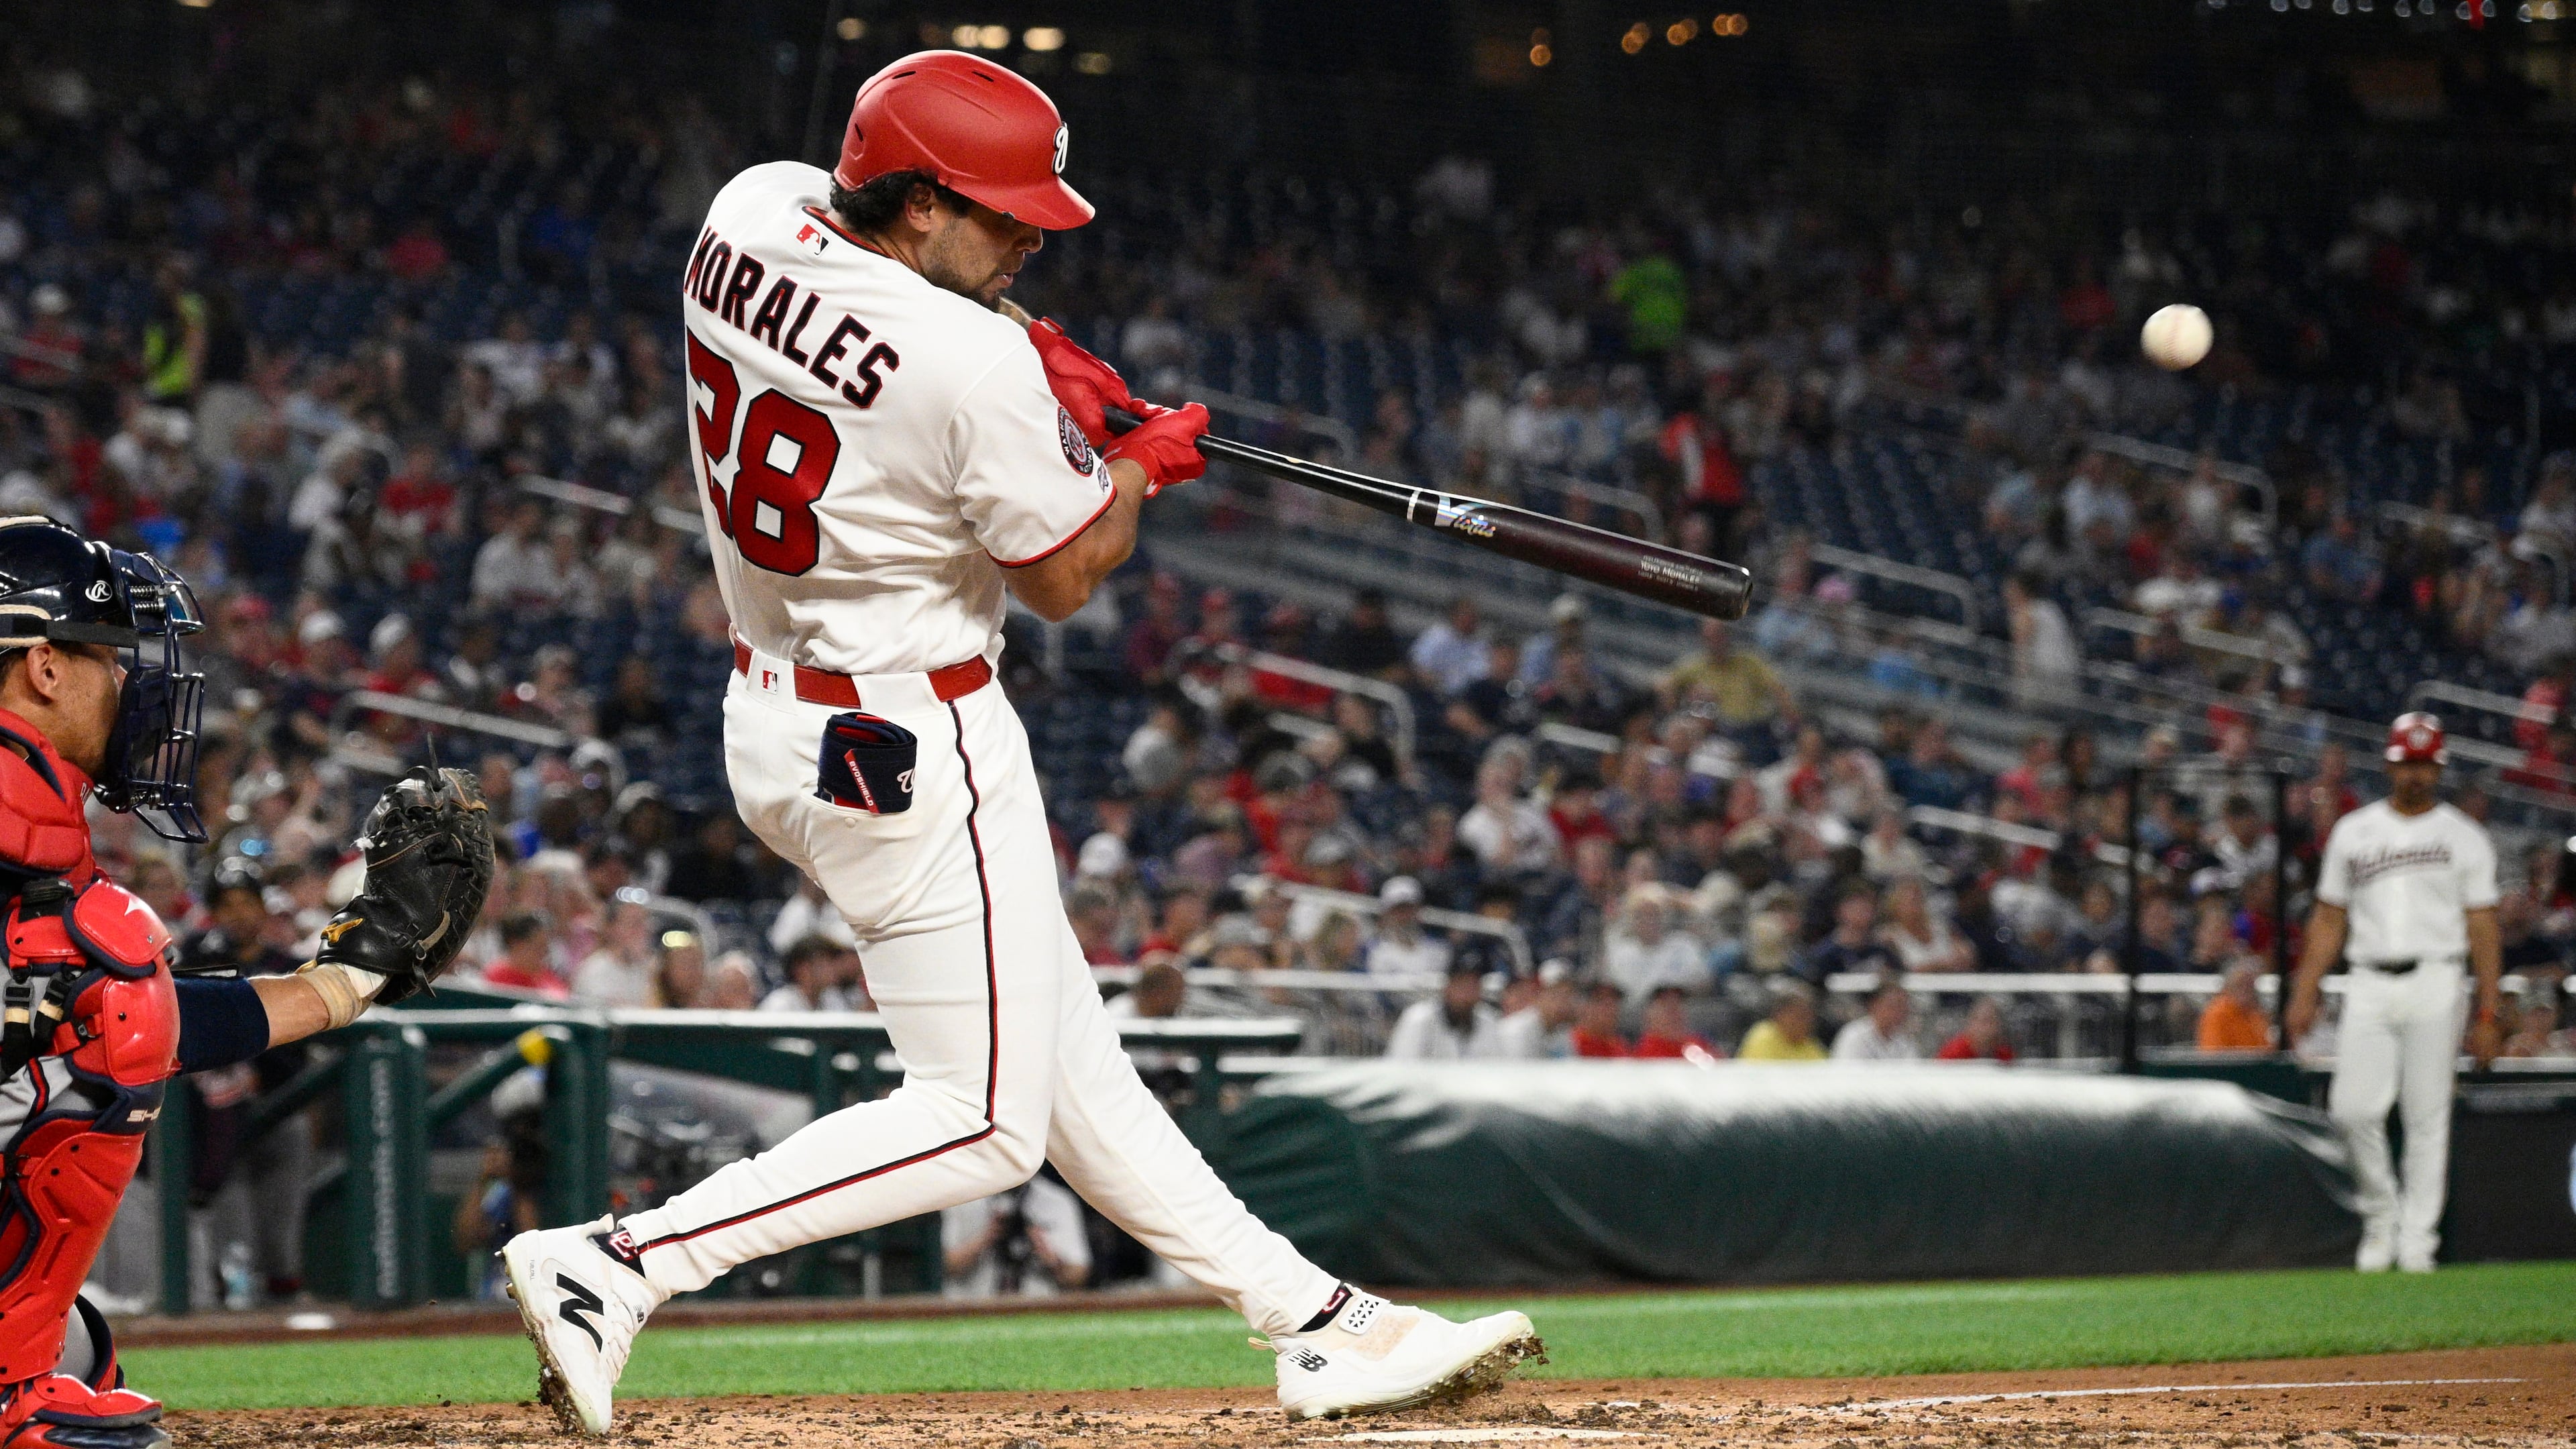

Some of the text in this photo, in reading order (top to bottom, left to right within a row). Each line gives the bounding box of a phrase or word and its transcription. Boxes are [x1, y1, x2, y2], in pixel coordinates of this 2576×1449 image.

[683, 224, 900, 409] MORALES
[686, 324, 841, 577] 28
[849, 761, 874, 806] EVOSHIELD
[556, 1272, 604, 1354] N
